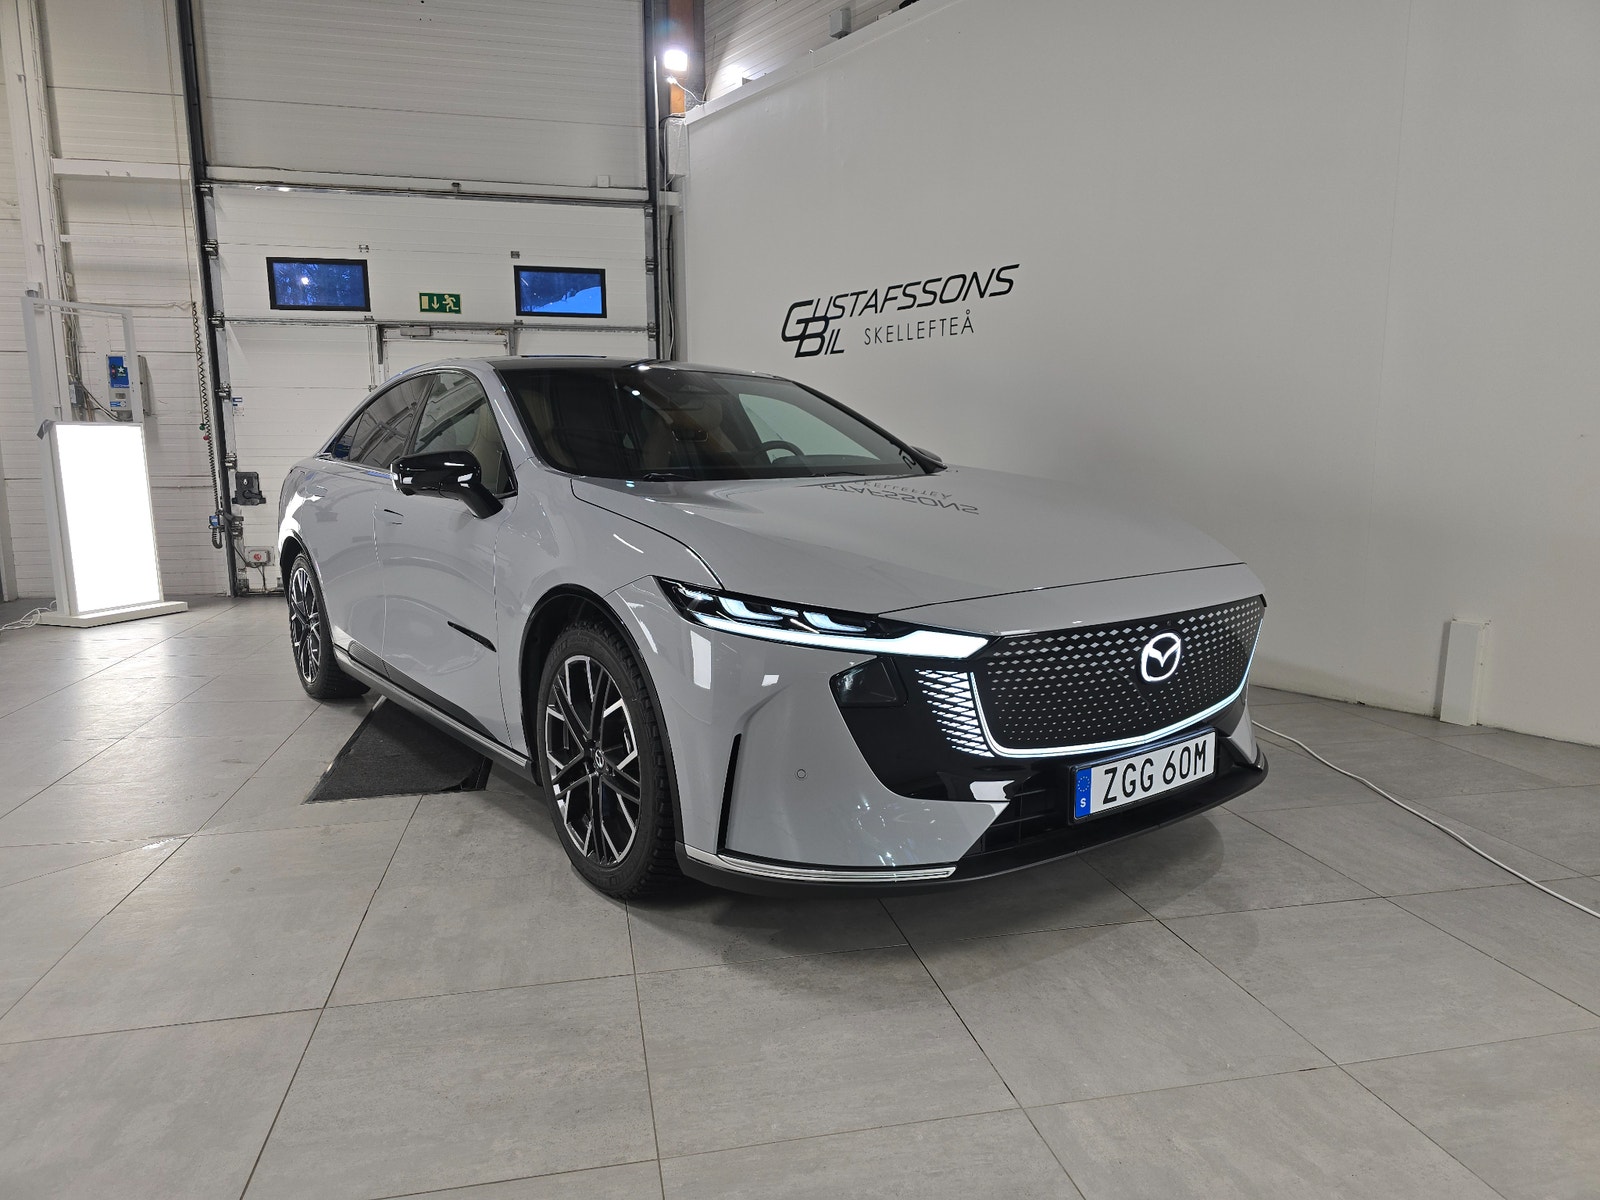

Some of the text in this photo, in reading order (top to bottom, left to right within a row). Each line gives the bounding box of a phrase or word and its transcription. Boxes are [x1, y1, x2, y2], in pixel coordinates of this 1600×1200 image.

[781, 263, 1020, 342] GUSTAFSSONS
[794, 315, 845, 358] BIL
[864, 309, 974, 345] SKELLEFTEÅ
[1103, 740, 1207, 805] ZGG 60M
[1080, 797, 1087, 808] S
